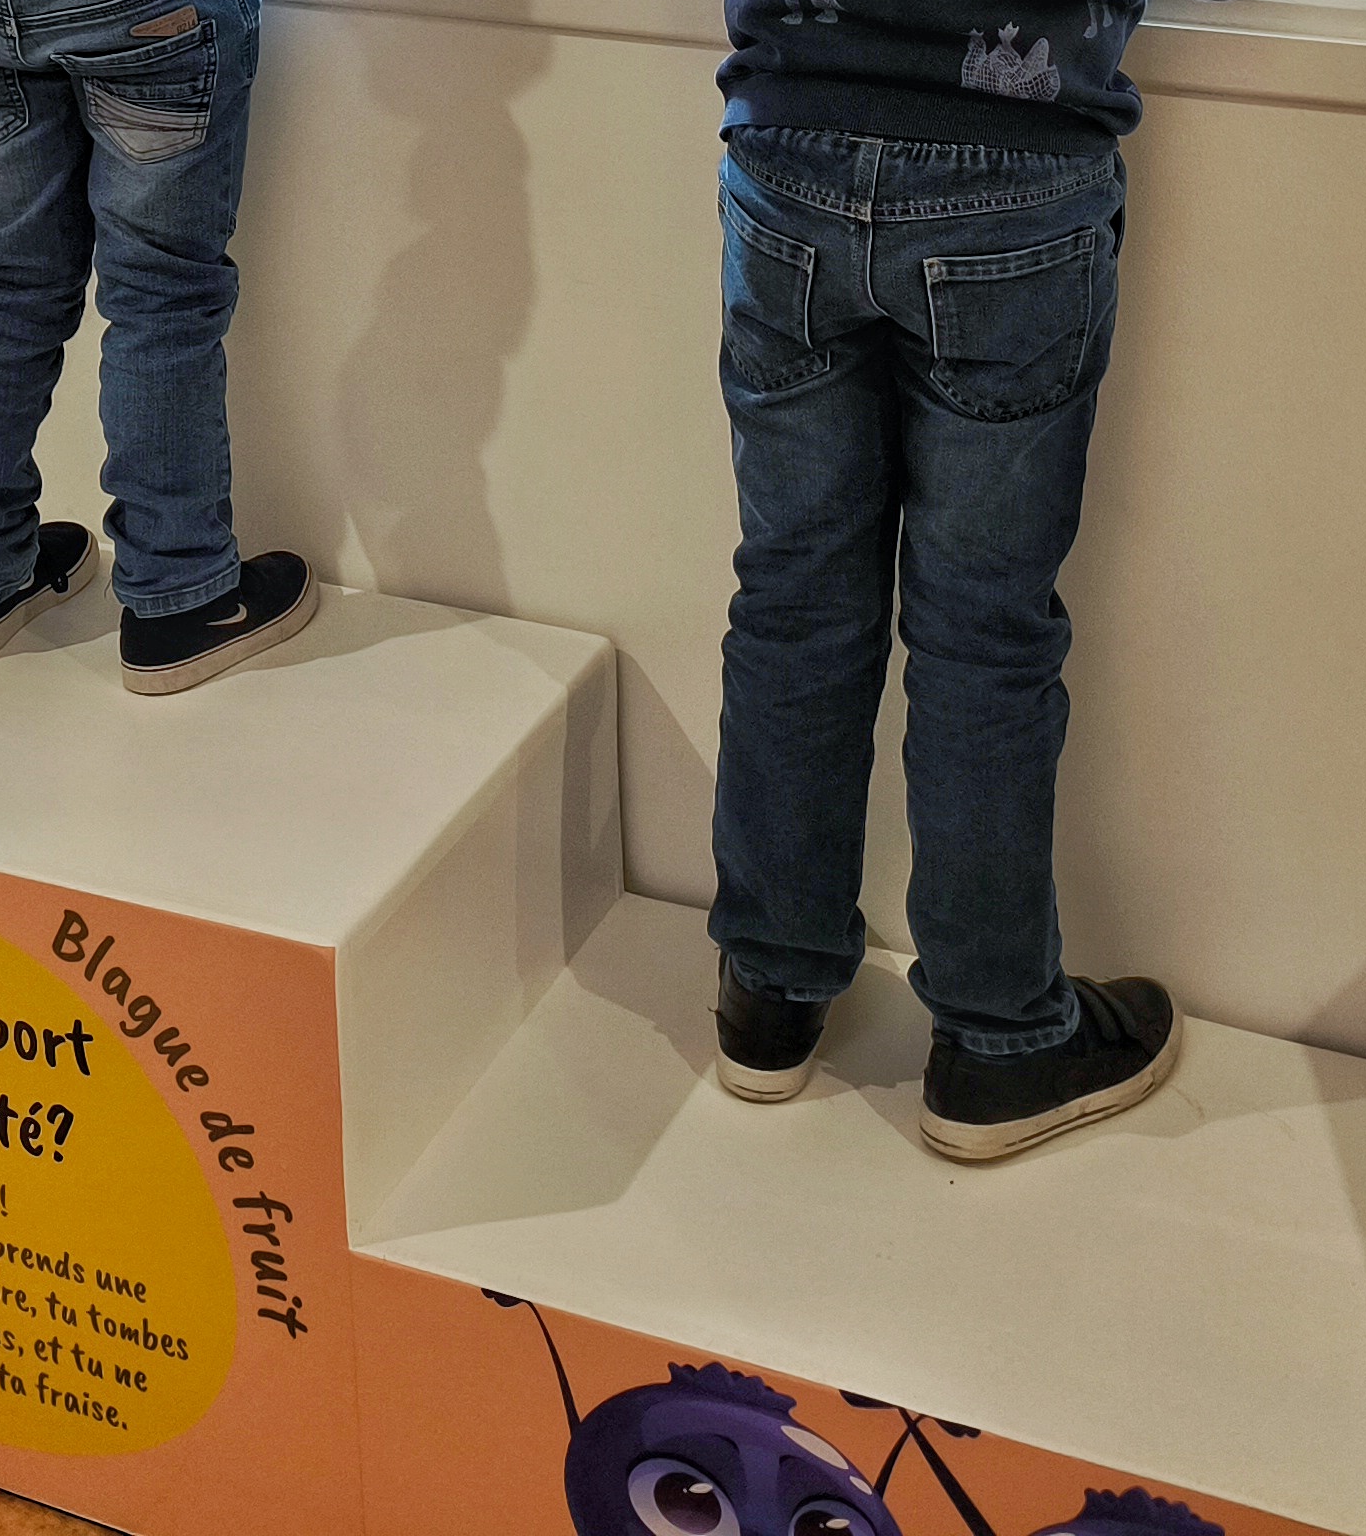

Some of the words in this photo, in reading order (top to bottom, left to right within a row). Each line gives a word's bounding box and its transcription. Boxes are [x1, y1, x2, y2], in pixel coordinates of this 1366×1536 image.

[51, 909, 210, 1093] Blague
[199, 1110, 255, 1173] de
[232, 1190, 308, 1340] fruit
[95, 1269, 147, 1304] une
[44, 1291, 78, 1328] tu
[85, 1303, 189, 1361] tombes
[33, 1335, 64, 1365] et
[70, 1342, 104, 1380] tu
[114, 1364, 148, 1393] ne
[35, 1371, 128, 1431] fraise.
